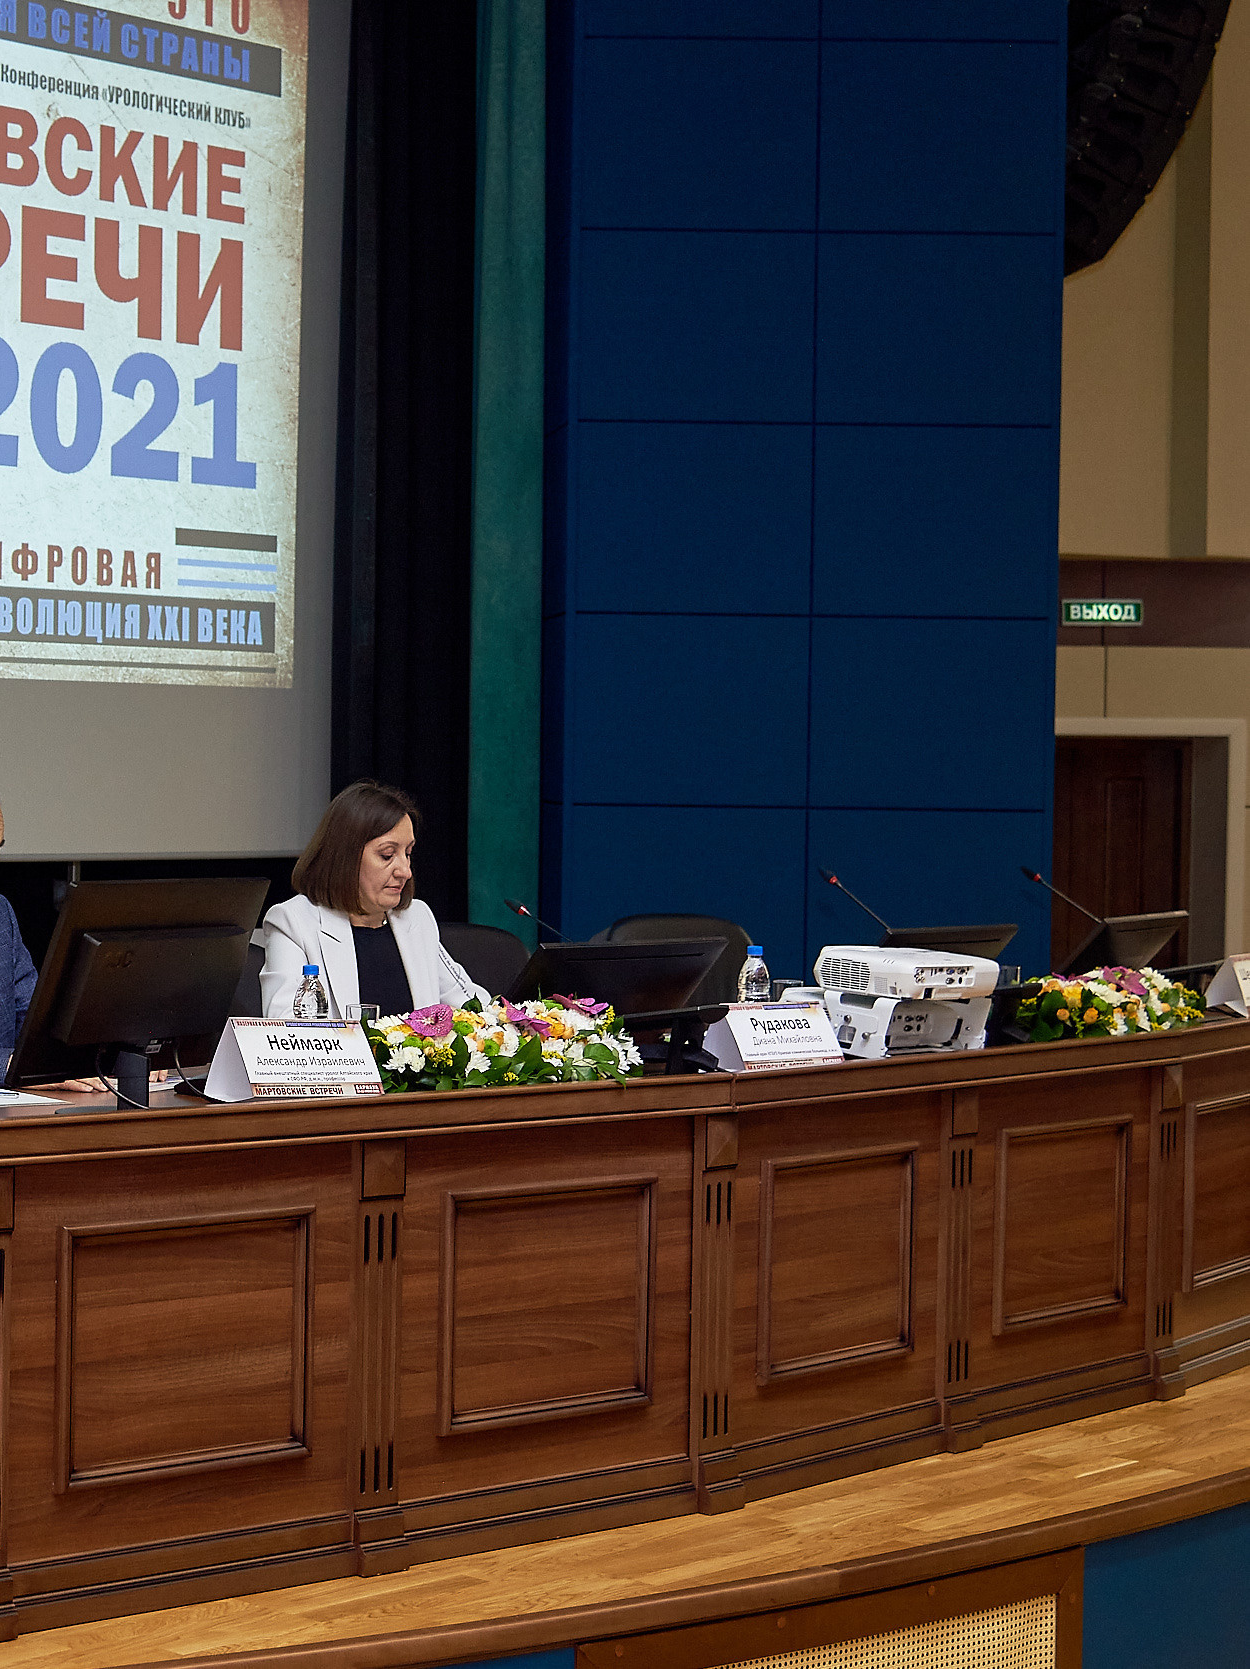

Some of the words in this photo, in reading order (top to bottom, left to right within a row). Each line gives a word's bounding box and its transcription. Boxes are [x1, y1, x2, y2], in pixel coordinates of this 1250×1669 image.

[28, 1, 111, 54] ВСЕЙ
[120, 23, 250, 83] СТРАНЫ
[0, 63, 99, 100] Конференция
[102, 84, 211, 123] «УРОЛОГИЧЕСКИЙ
[214, 106, 251, 129] КЛУБ»
[1069, 604, 1136, 621] ВЫХОД
[148, 607, 189, 642] XXI
[197, 609, 263, 647] ВЕКА
[750, 1017, 811, 1035] Рудакова
[266, 1033, 344, 1055] Неймарк
[256, 1056, 308, 1069] Александр
[309, 1056, 366, 1068] Израилевич
[255, 1087, 307, 1096] МАРТОВСКИЕ
[310, 1087, 344, 1095] ВСТРЕЧИ
